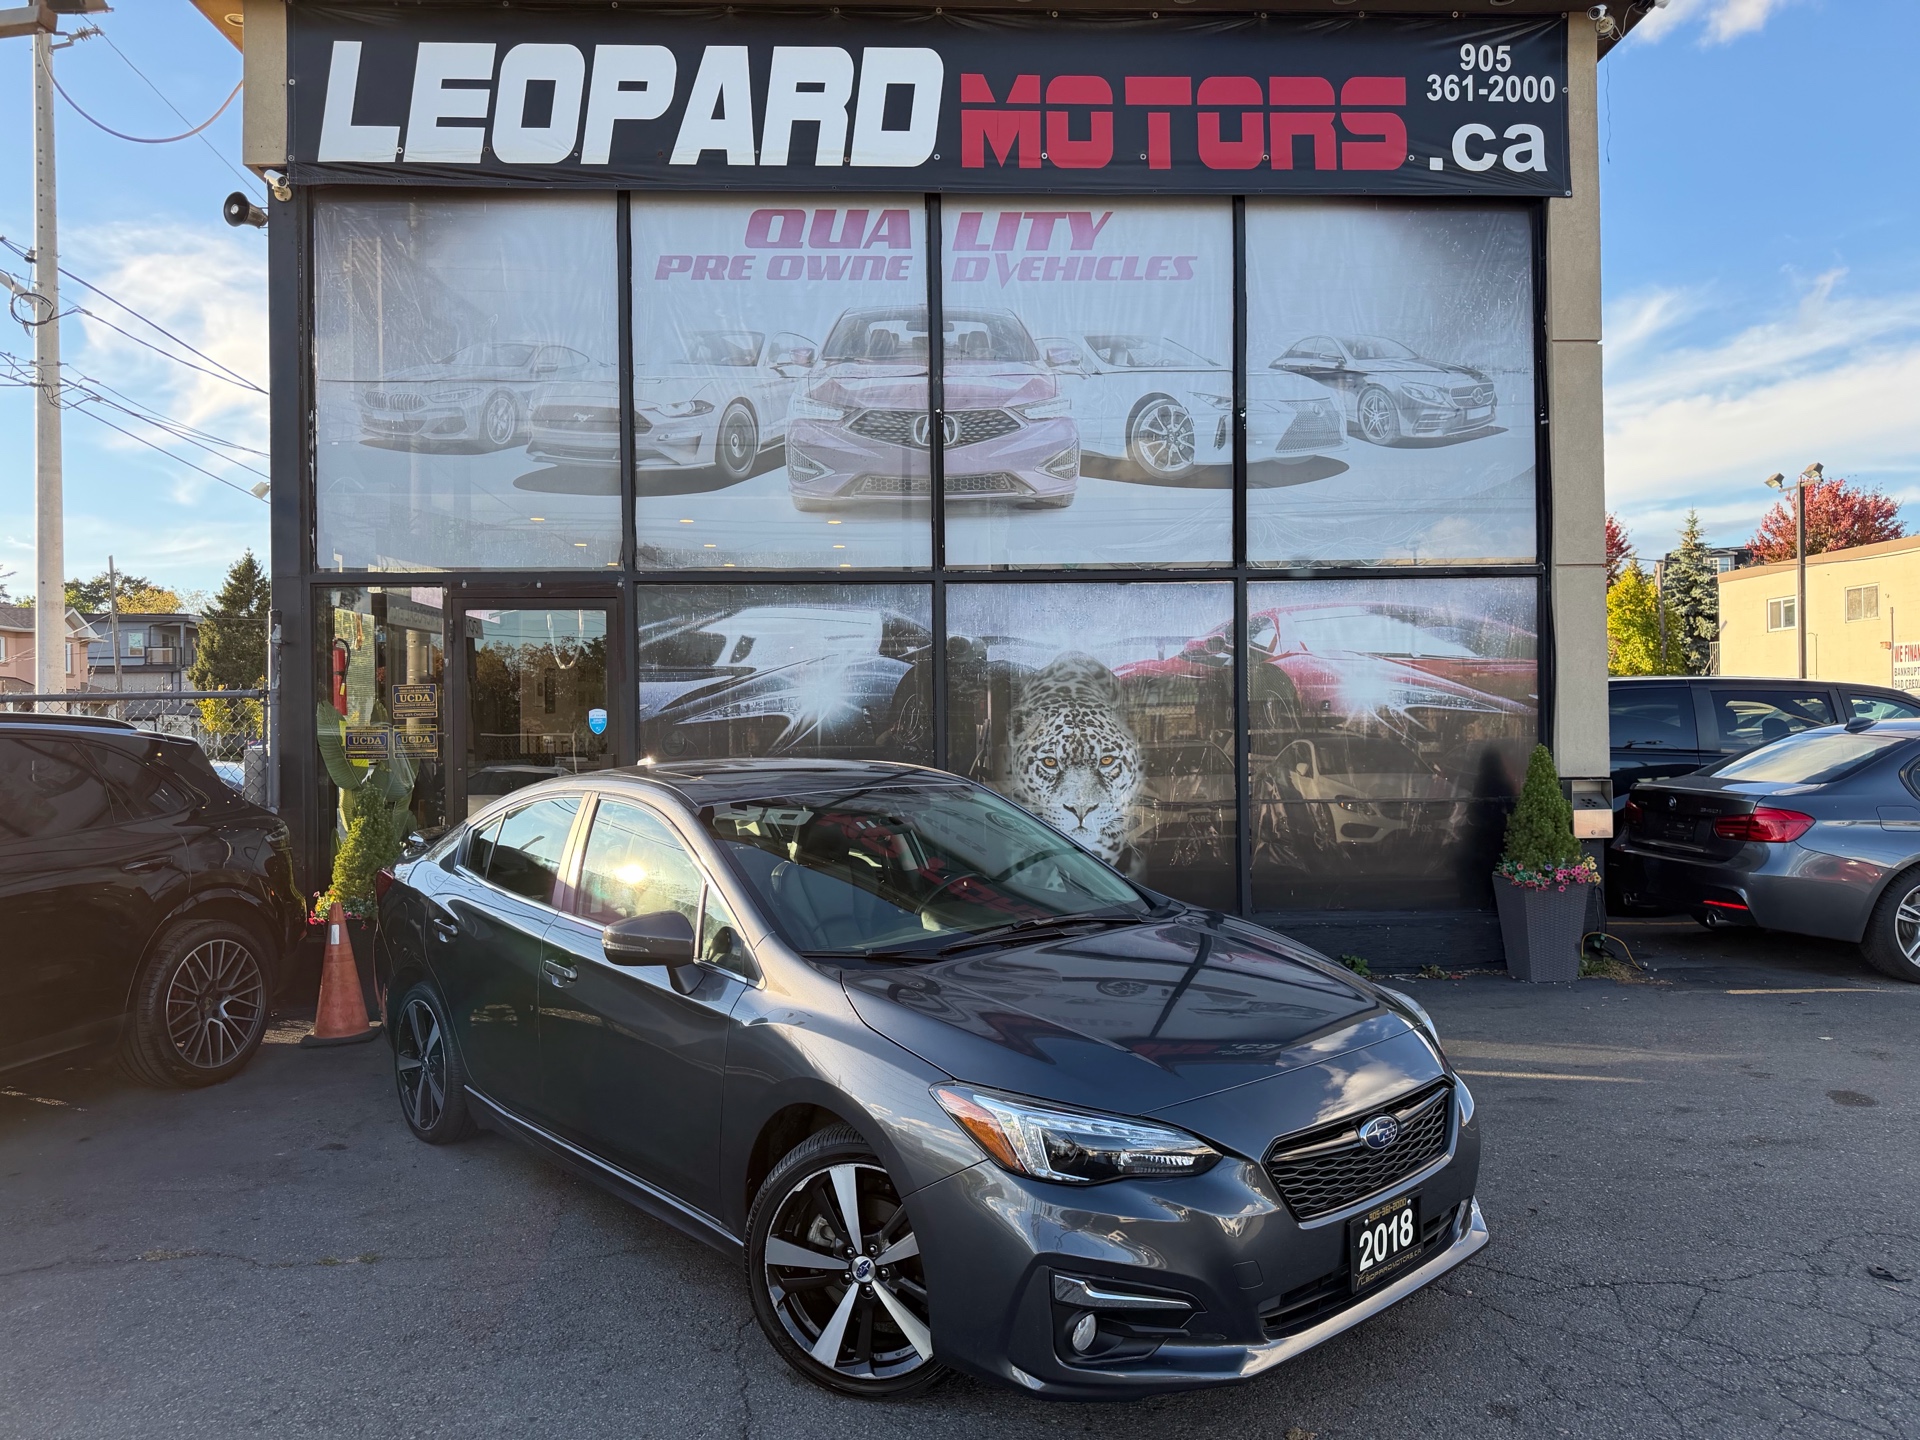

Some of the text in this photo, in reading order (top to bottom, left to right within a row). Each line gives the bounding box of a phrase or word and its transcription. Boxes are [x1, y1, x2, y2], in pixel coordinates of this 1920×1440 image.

[1459, 45, 1512, 73] 905
[1426, 74, 1556, 103] 361-2000
[317, 40, 1549, 173] LEOPARD MOTORS .ca
[744, 208, 1114, 252] QUA LITY
[654, 255, 756, 281] PRE
[765, 255, 913, 281] OWNE
[1894, 645, 1903, 663] WE
[399, 693, 431, 703] UCDA
[352, 736, 382, 745] UCDA
[401, 735, 431, 744] UCDA
[1369, 1197, 1407, 1222] 905-361-2000
[1359, 1208, 1414, 1272] 2018
